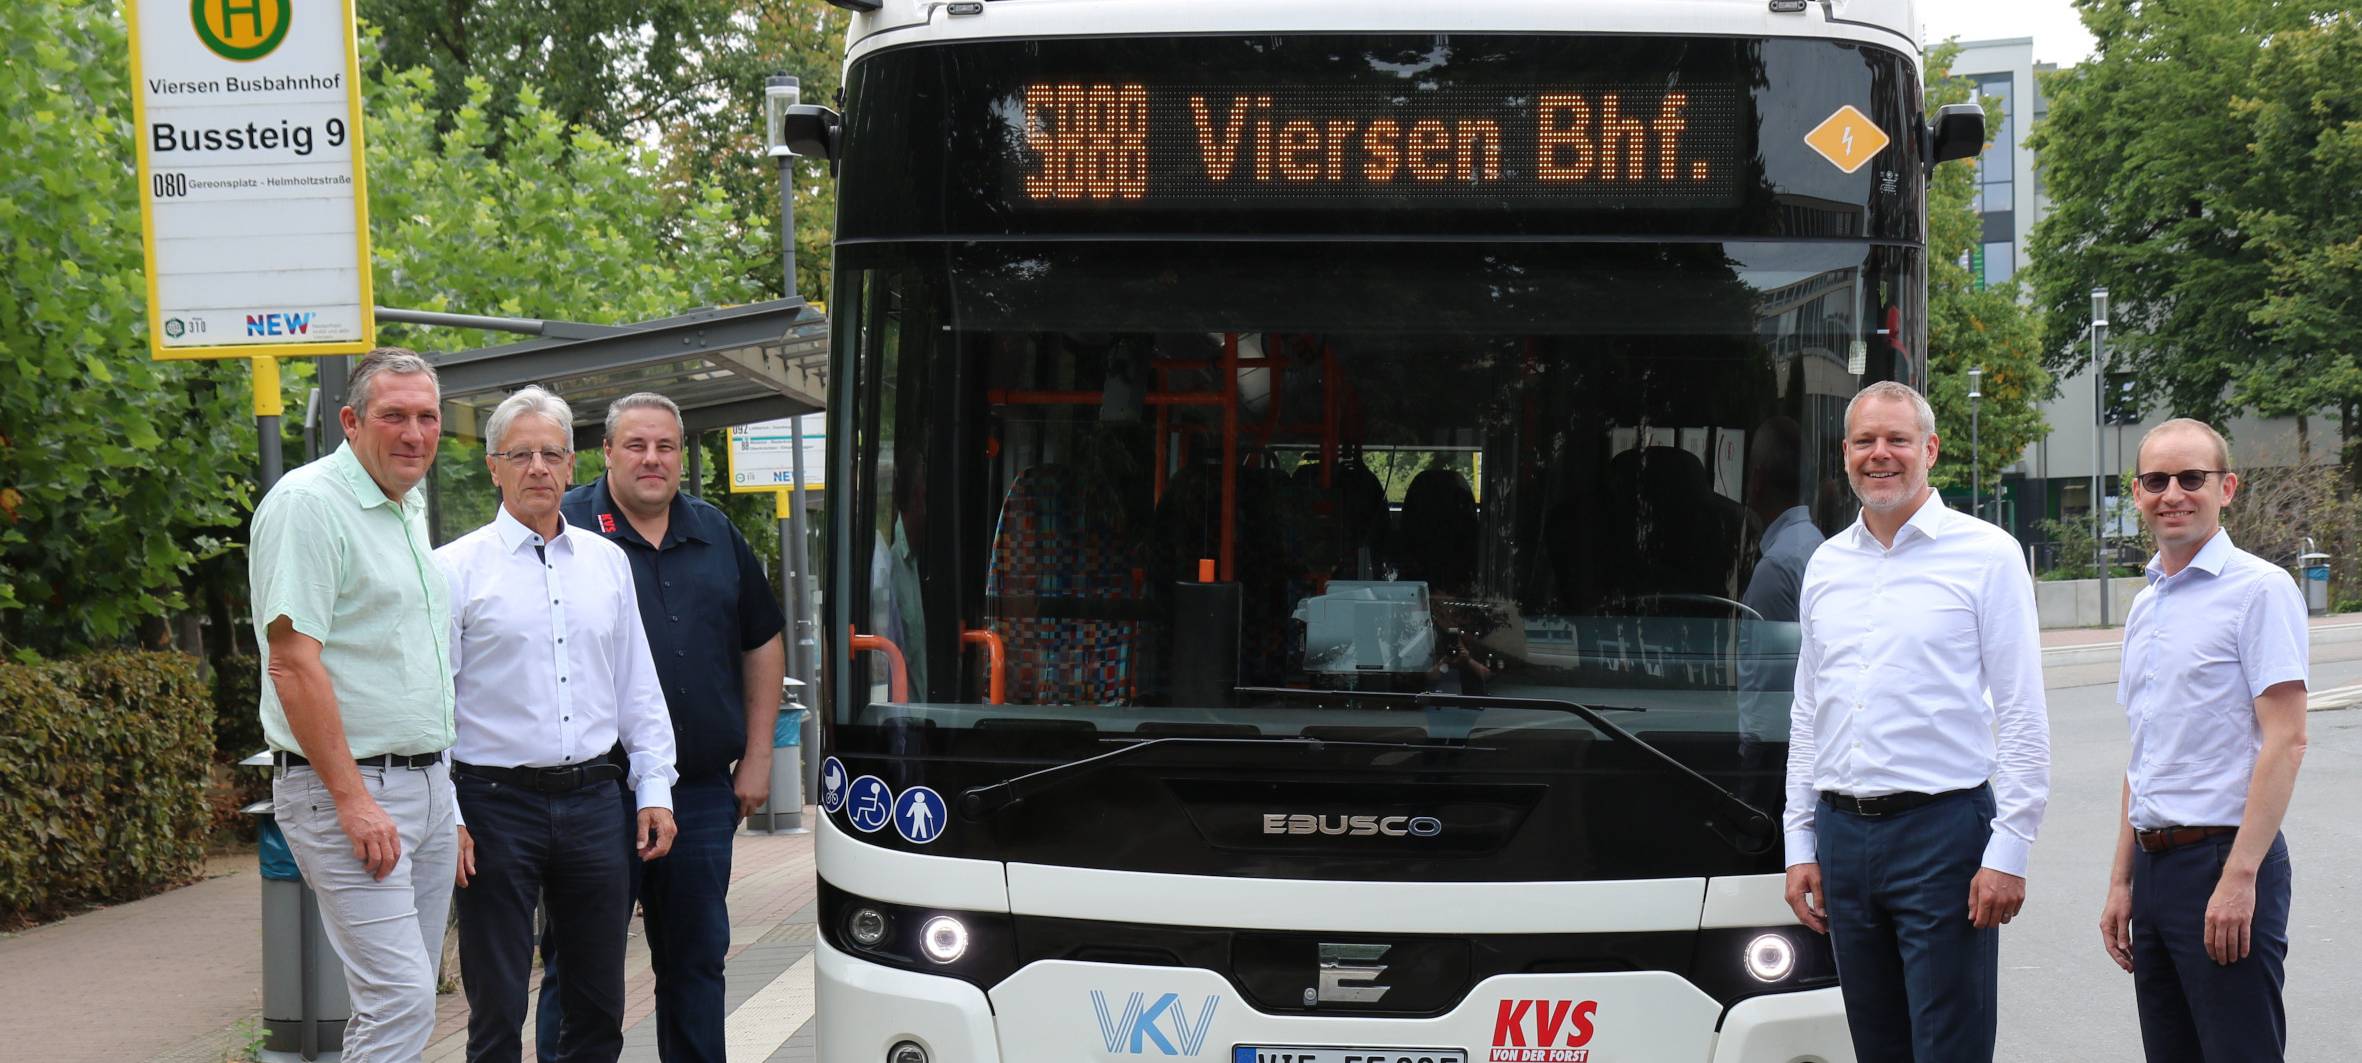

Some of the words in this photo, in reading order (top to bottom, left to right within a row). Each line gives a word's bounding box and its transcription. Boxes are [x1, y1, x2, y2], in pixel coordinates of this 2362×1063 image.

[221, 0, 262, 38] H
[149, 78, 219, 94] Viersen
[226, 74, 341, 93] Busbahnhof
[152, 119, 313, 155] Bussteig
[325, 117, 346, 147] 9
[1190, 96, 1499, 181] Viersen
[1536, 94, 1708, 181] Bhf.
[153, 173, 187, 197] 080
[188, 178, 257, 189] Gereonsplatz
[267, 175, 351, 186] Helmholtzstraße
[246, 312, 311, 337] NEW
[773, 471, 796, 482] NE
[1263, 814, 1442, 837] EBUSCO
[1090, 990, 1221, 1056] VKV
[1492, 999, 1598, 1048] KVS
[1492, 1049, 1520, 1062] VON
[1521, 1049, 1546, 1062] DER
[1549, 1050, 1588, 1063] FORST
